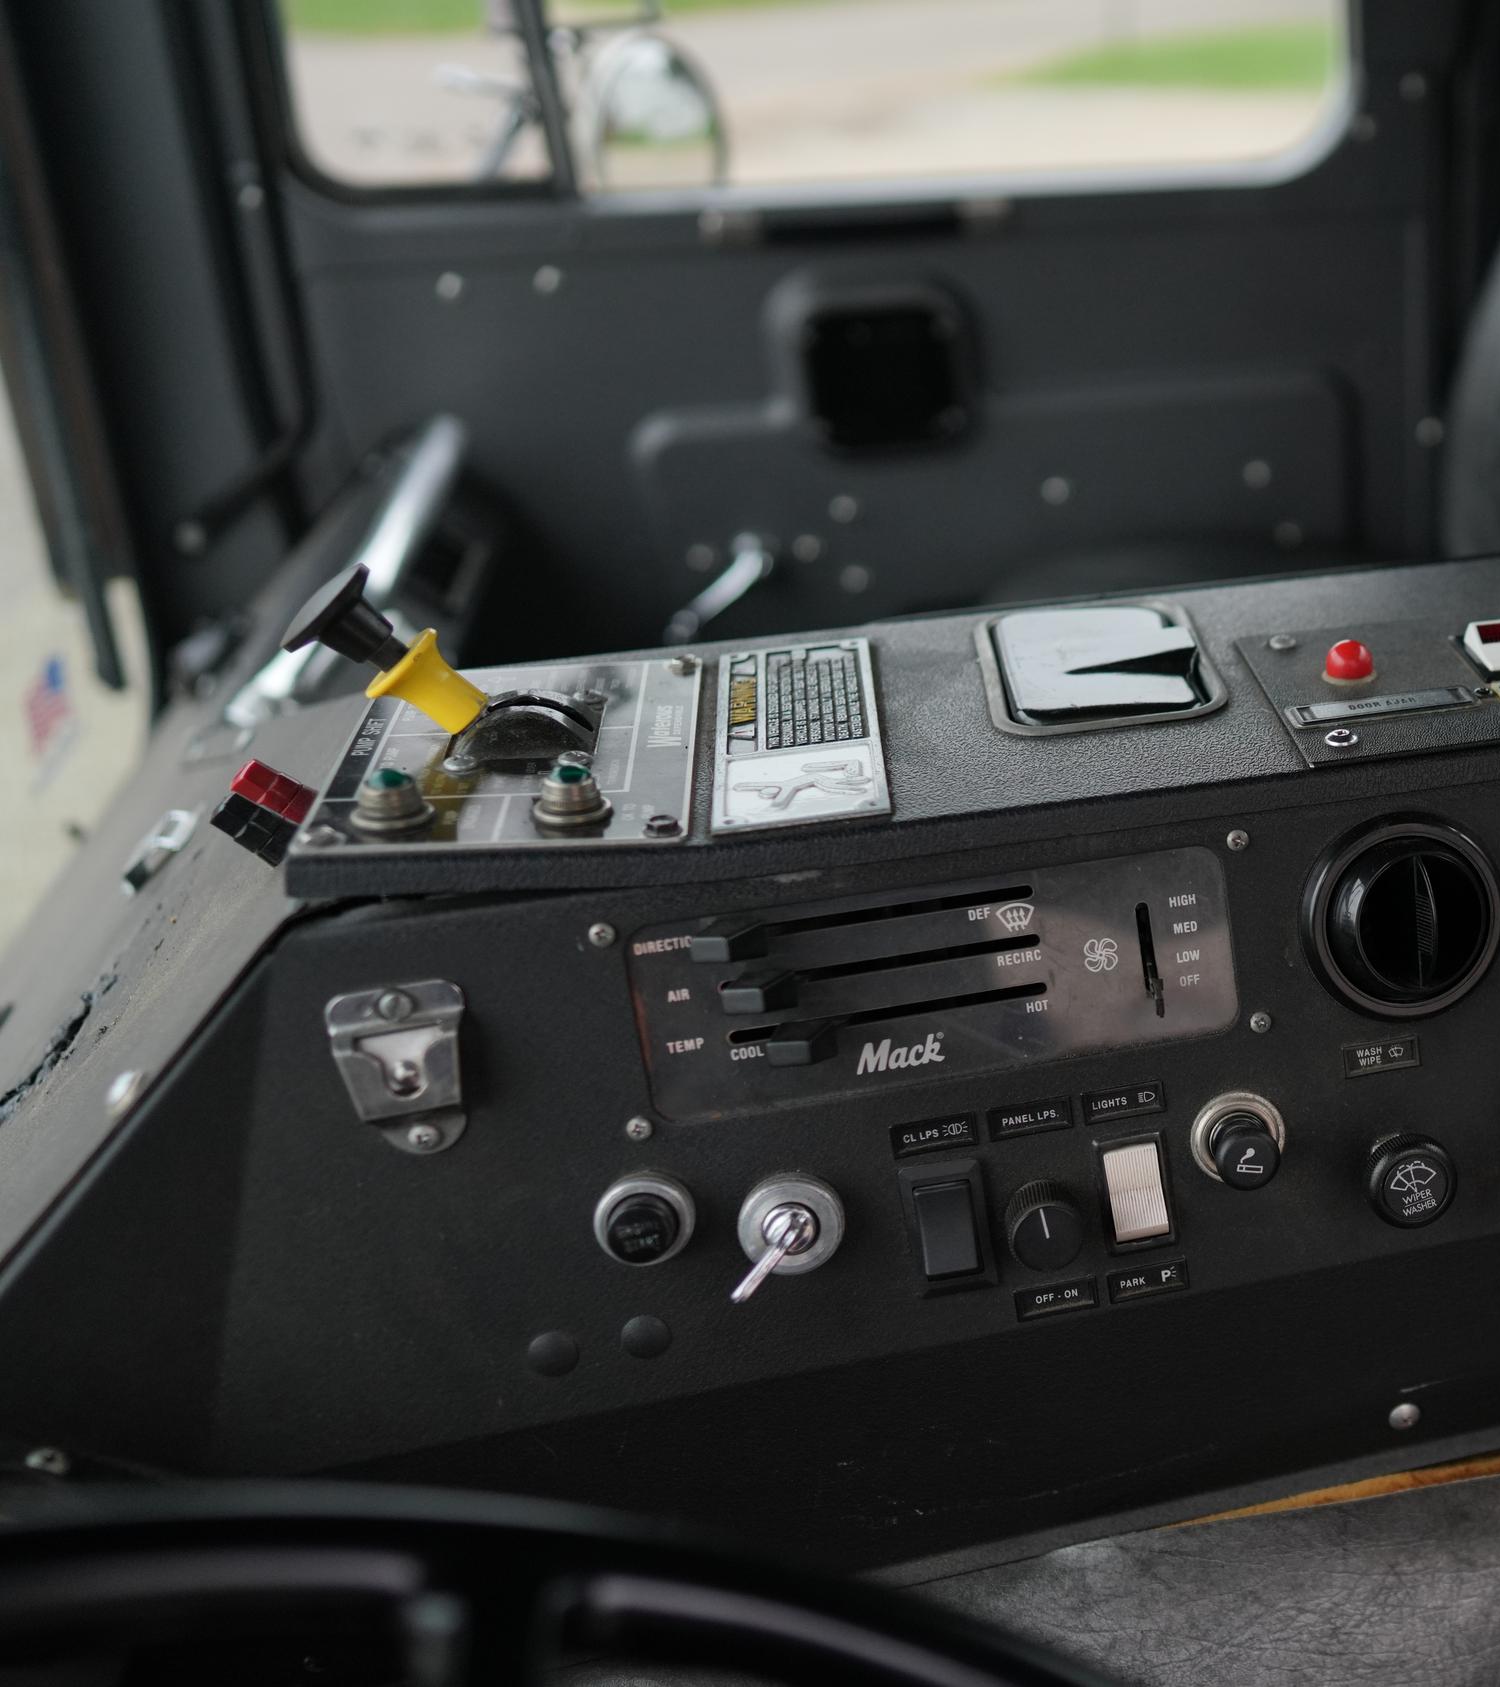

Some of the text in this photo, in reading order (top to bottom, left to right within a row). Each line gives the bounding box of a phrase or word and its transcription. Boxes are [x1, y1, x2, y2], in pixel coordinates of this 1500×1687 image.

[730, 677, 756, 725] WARNING
[1348, 701, 1381, 711] DOOR
[350, 718, 387, 756] PUMP SHIFT
[1168, 893, 1196, 908] HIGH
[968, 907, 991, 921] DEF
[1173, 920, 1198, 935] MED
[633, 936, 693, 956] DIRECTIO
[996, 949, 1042, 967] RECIRC
[1176, 949, 1200, 964] LOW
[1180, 974, 1200, 987] OFF
[667, 988, 690, 1003] AIR
[1026, 1000, 1049, 1014] HOT
[666, 1037, 704, 1054] TEMP
[730, 1045, 765, 1061] COOL
[1356, 1046, 1383, 1058] WASH
[1359, 1055, 1383, 1067] WIPE
[1092, 1096, 1128, 1111] LIGHTS
[1002, 1108, 1060, 1127] PANEL LPS.
[903, 1128, 940, 1144] CL LPS
[1402, 1188, 1433, 1205] WIPER
[1403, 1199, 1437, 1217] WASHER
[1120, 1276, 1147, 1289] PARK
[1035, 1292, 1055, 1304] OFF
[1064, 1288, 1079, 1299] ON
